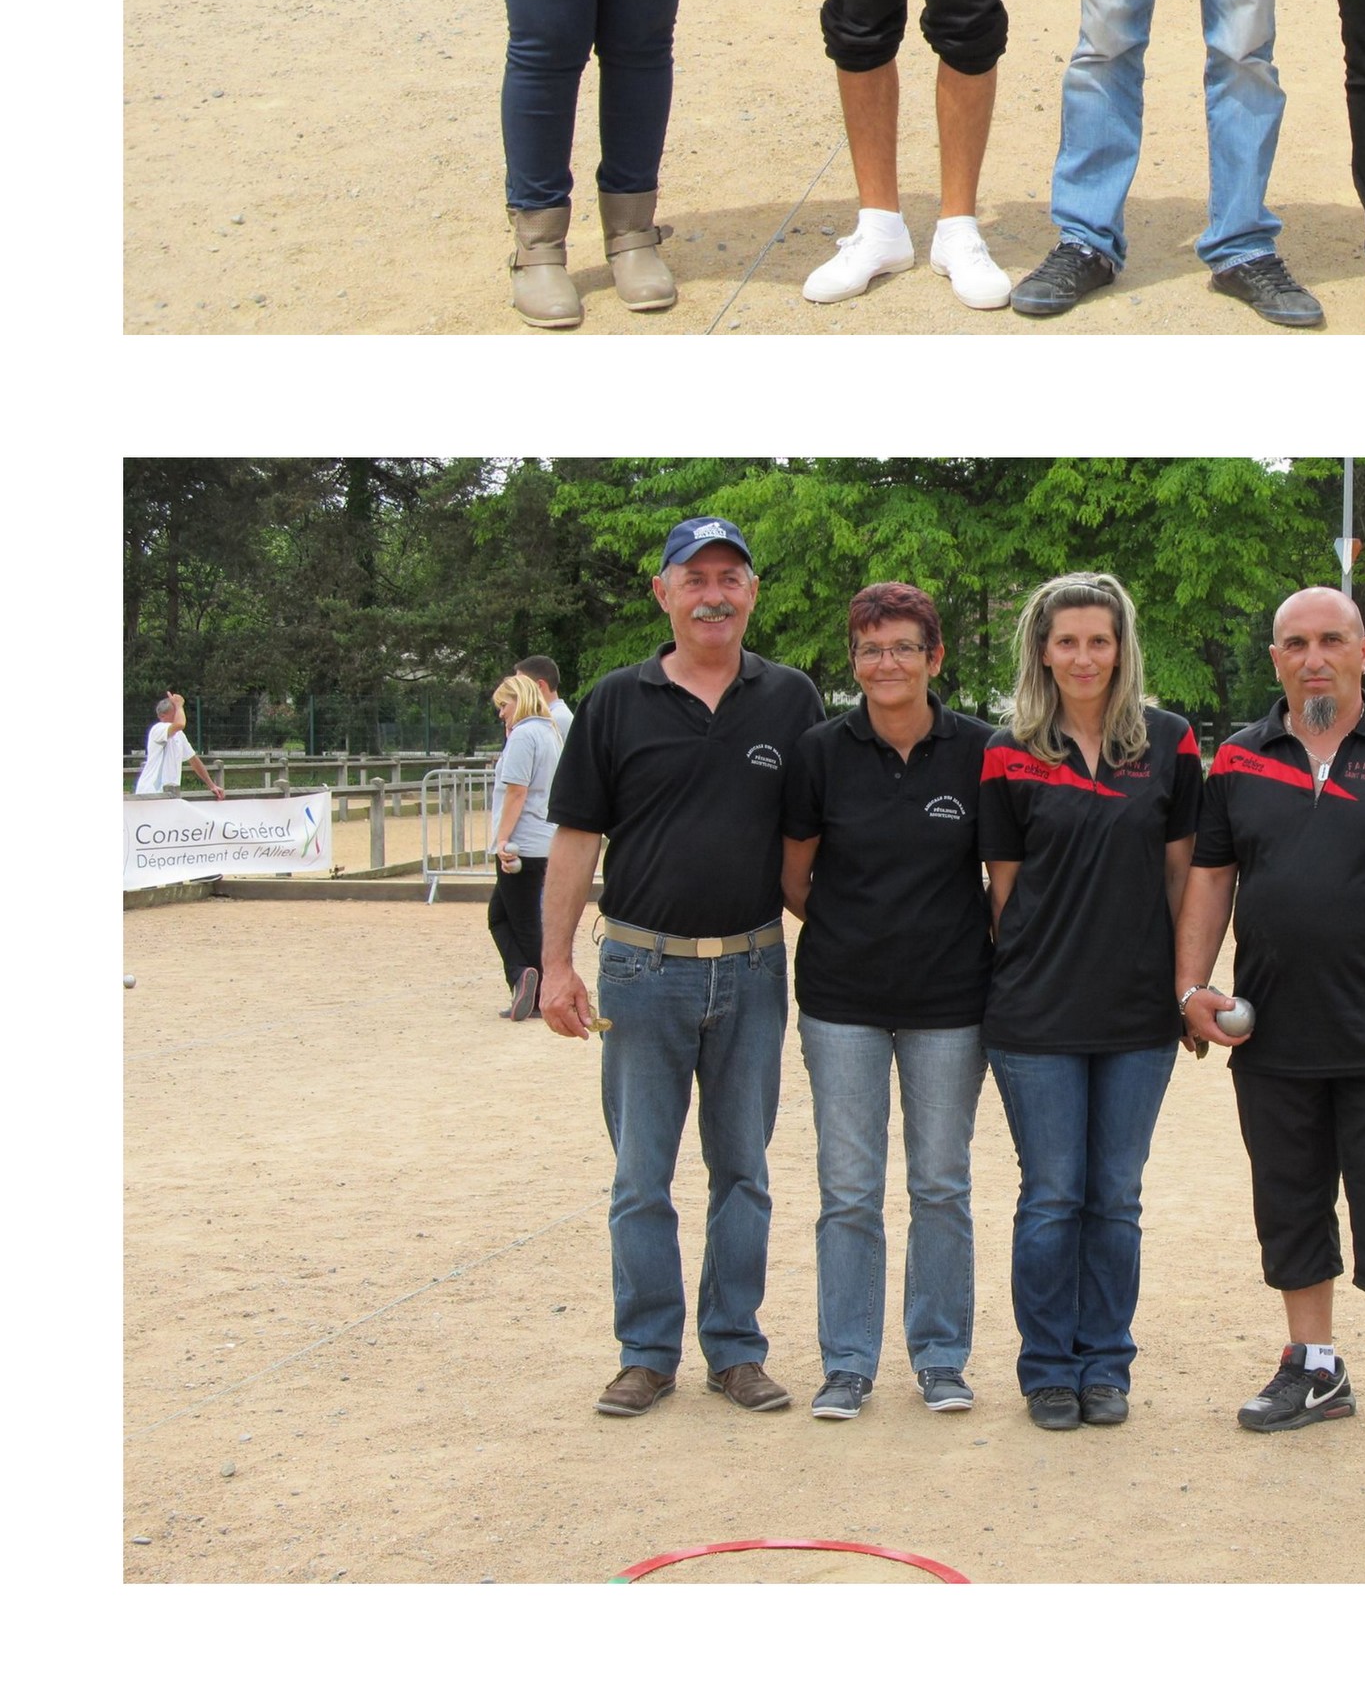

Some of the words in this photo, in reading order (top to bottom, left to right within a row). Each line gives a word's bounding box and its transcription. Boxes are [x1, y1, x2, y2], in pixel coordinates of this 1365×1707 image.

[135, 820, 214, 845] Conseil
[222, 819, 291, 840] Général
[136, 848, 228, 870] Département
[232, 846, 249, 860] de
[253, 846, 296, 859] l'Allier
